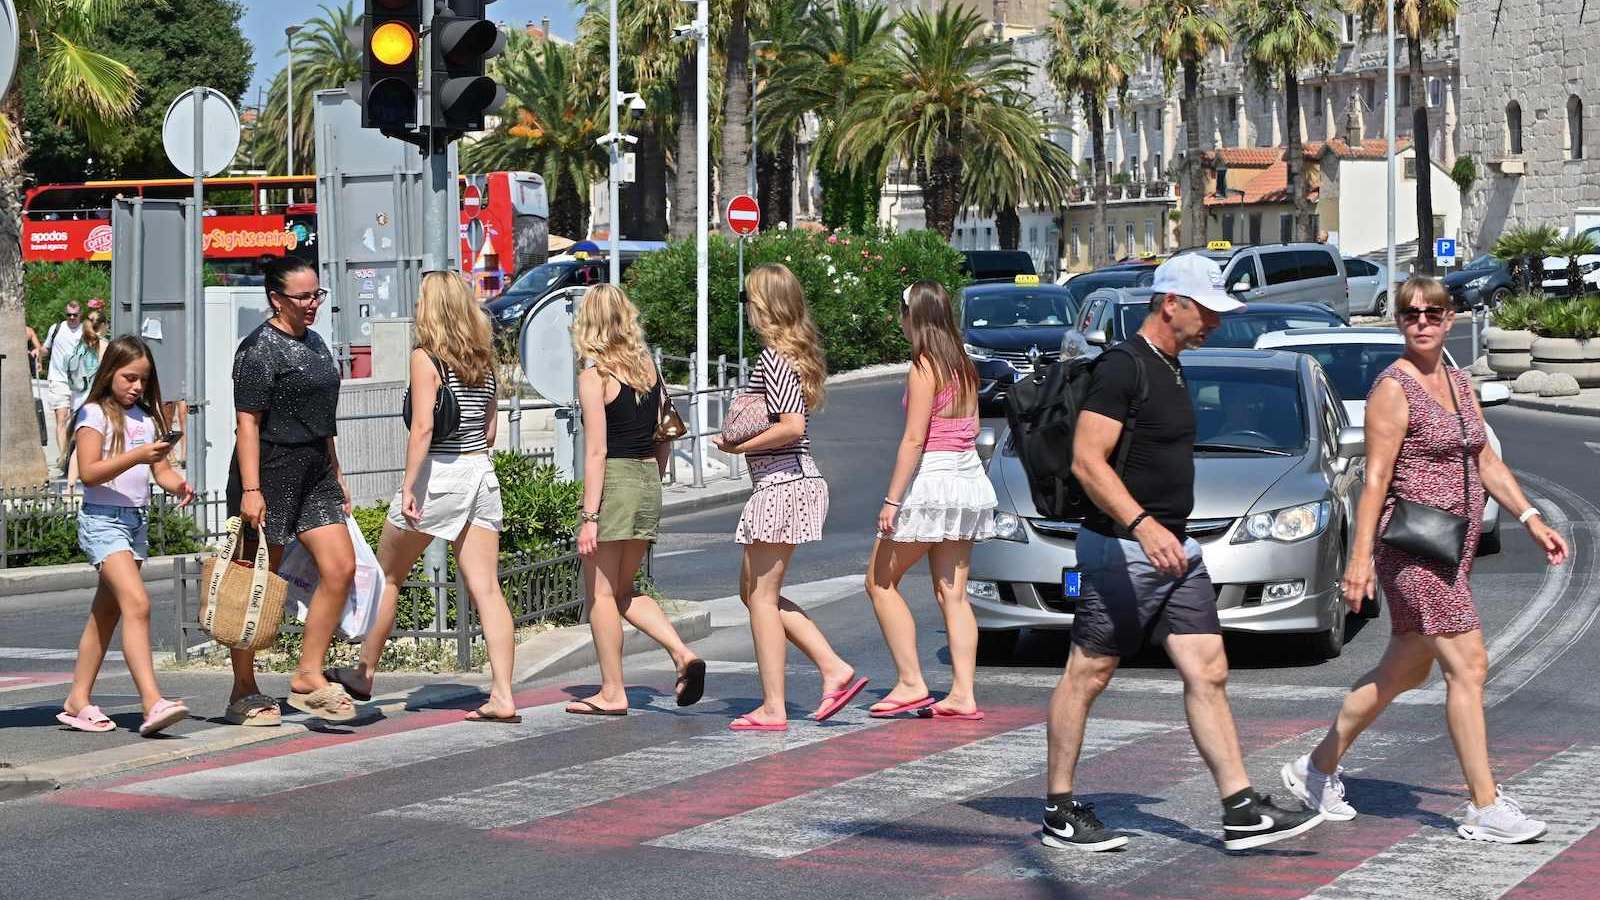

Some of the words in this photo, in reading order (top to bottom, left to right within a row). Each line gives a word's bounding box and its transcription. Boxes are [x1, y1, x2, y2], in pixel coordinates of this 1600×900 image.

[31, 230, 68, 243] apodos
[211, 229, 298, 251] Sightseeing
[1442, 241, 1451, 254] P
